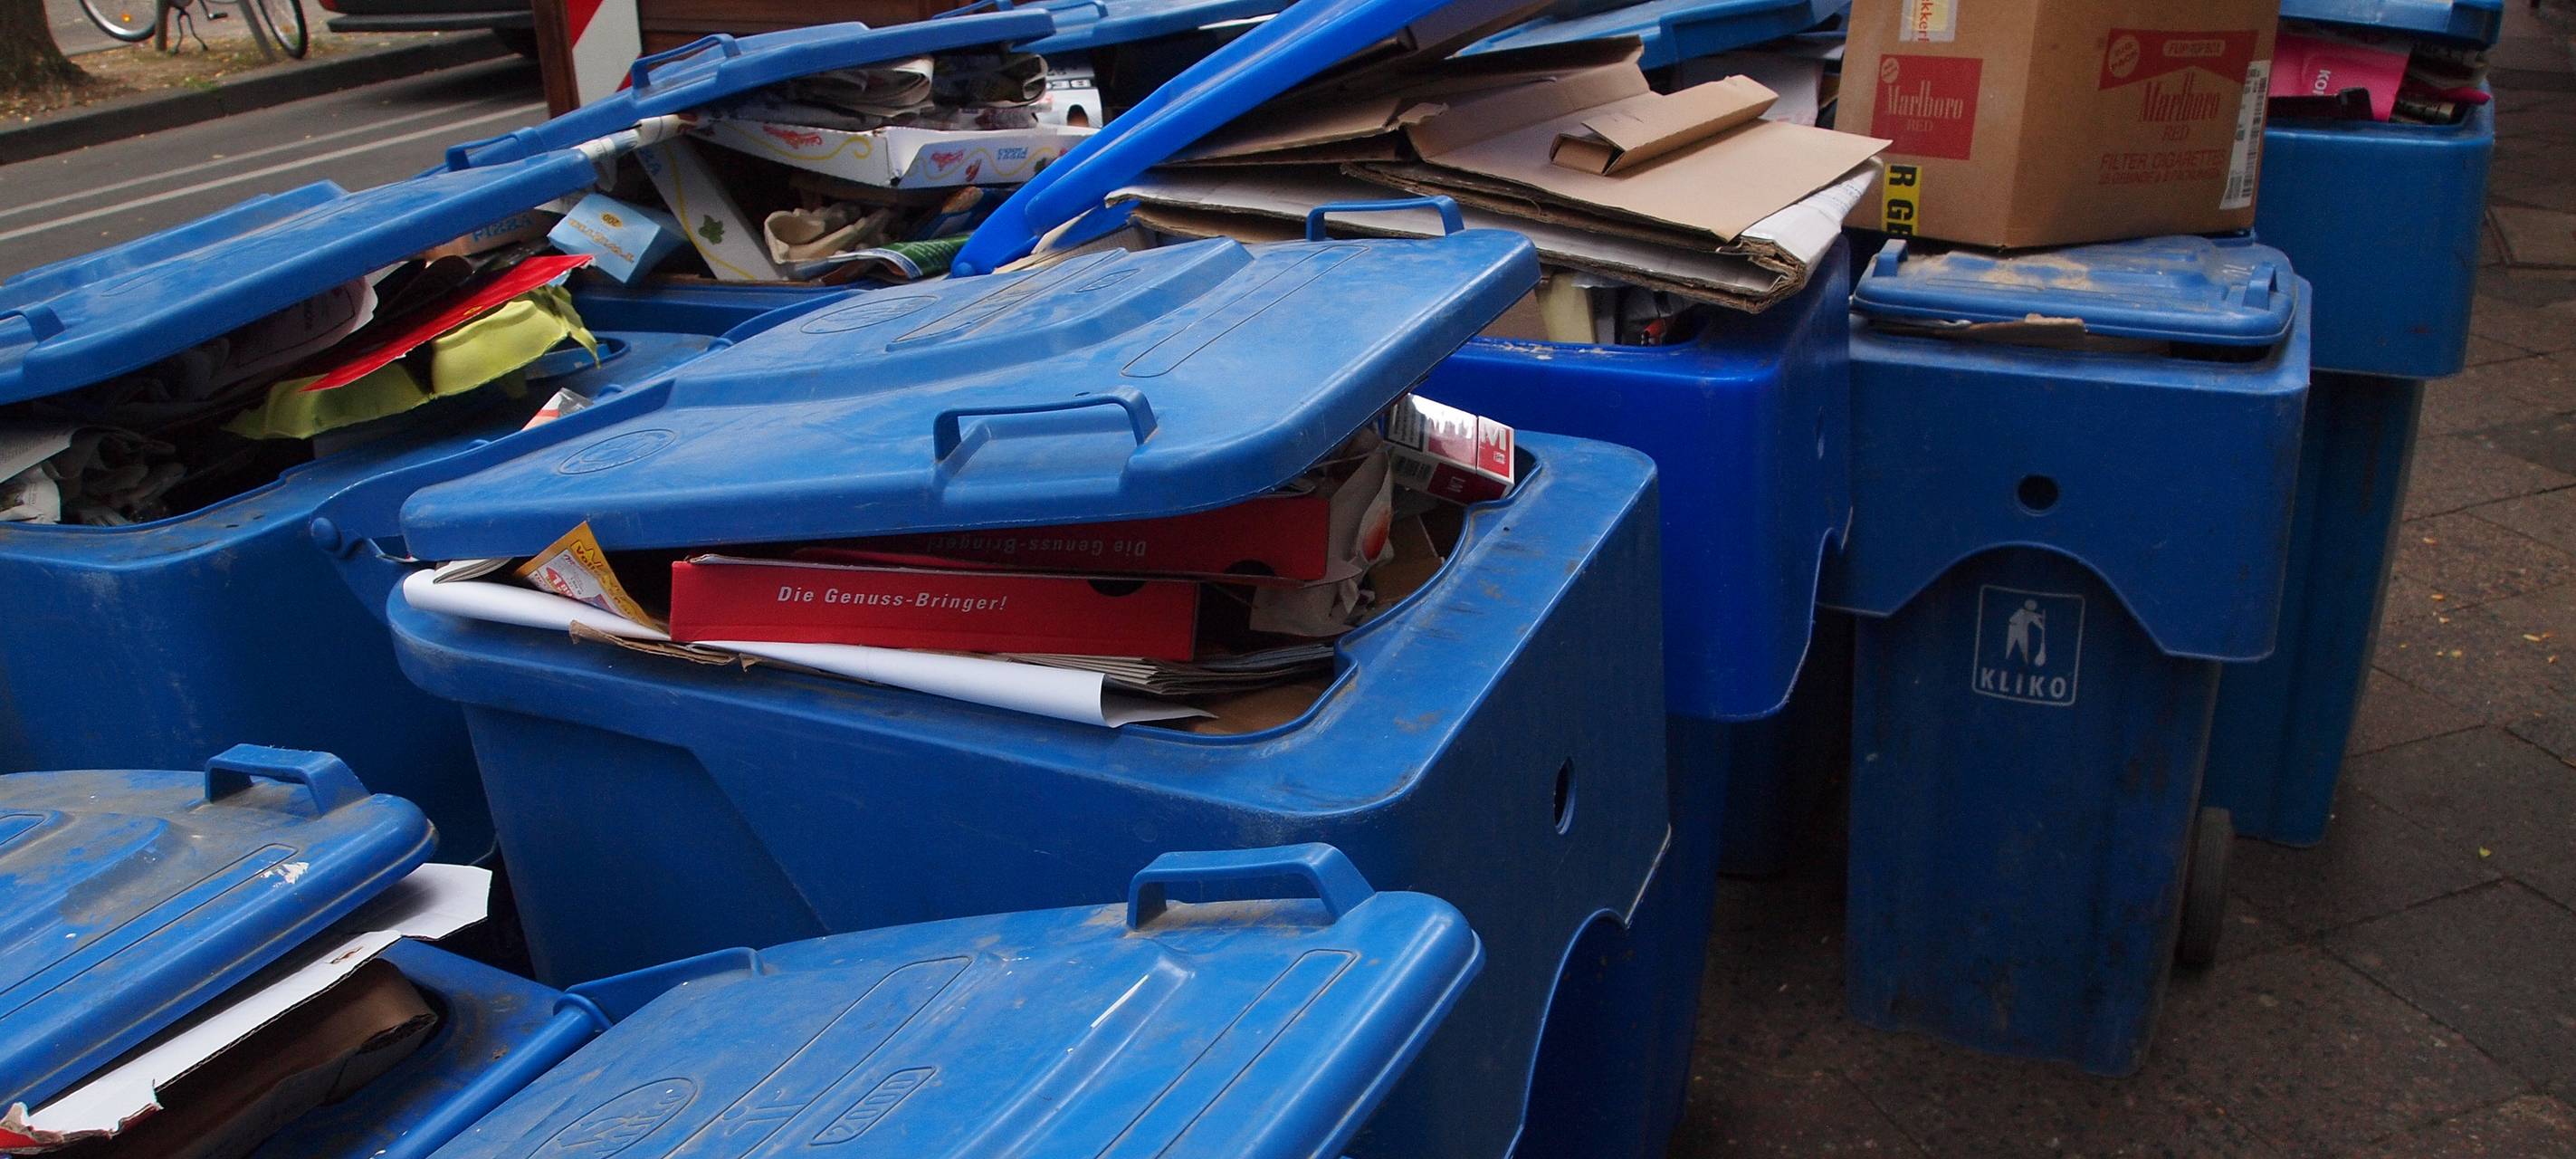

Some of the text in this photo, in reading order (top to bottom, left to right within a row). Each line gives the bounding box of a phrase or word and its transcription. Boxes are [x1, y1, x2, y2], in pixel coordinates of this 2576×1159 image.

[1886, 80, 1964, 120] Marlboro
[2140, 72, 2219, 121] Marlboro
[2100, 152, 2149, 171] FILTER
[1113, 541, 1147, 557] Die
[777, 586, 1007, 612] Die Genuss-Bringer!
[1980, 667, 2066, 699] KLIKO
